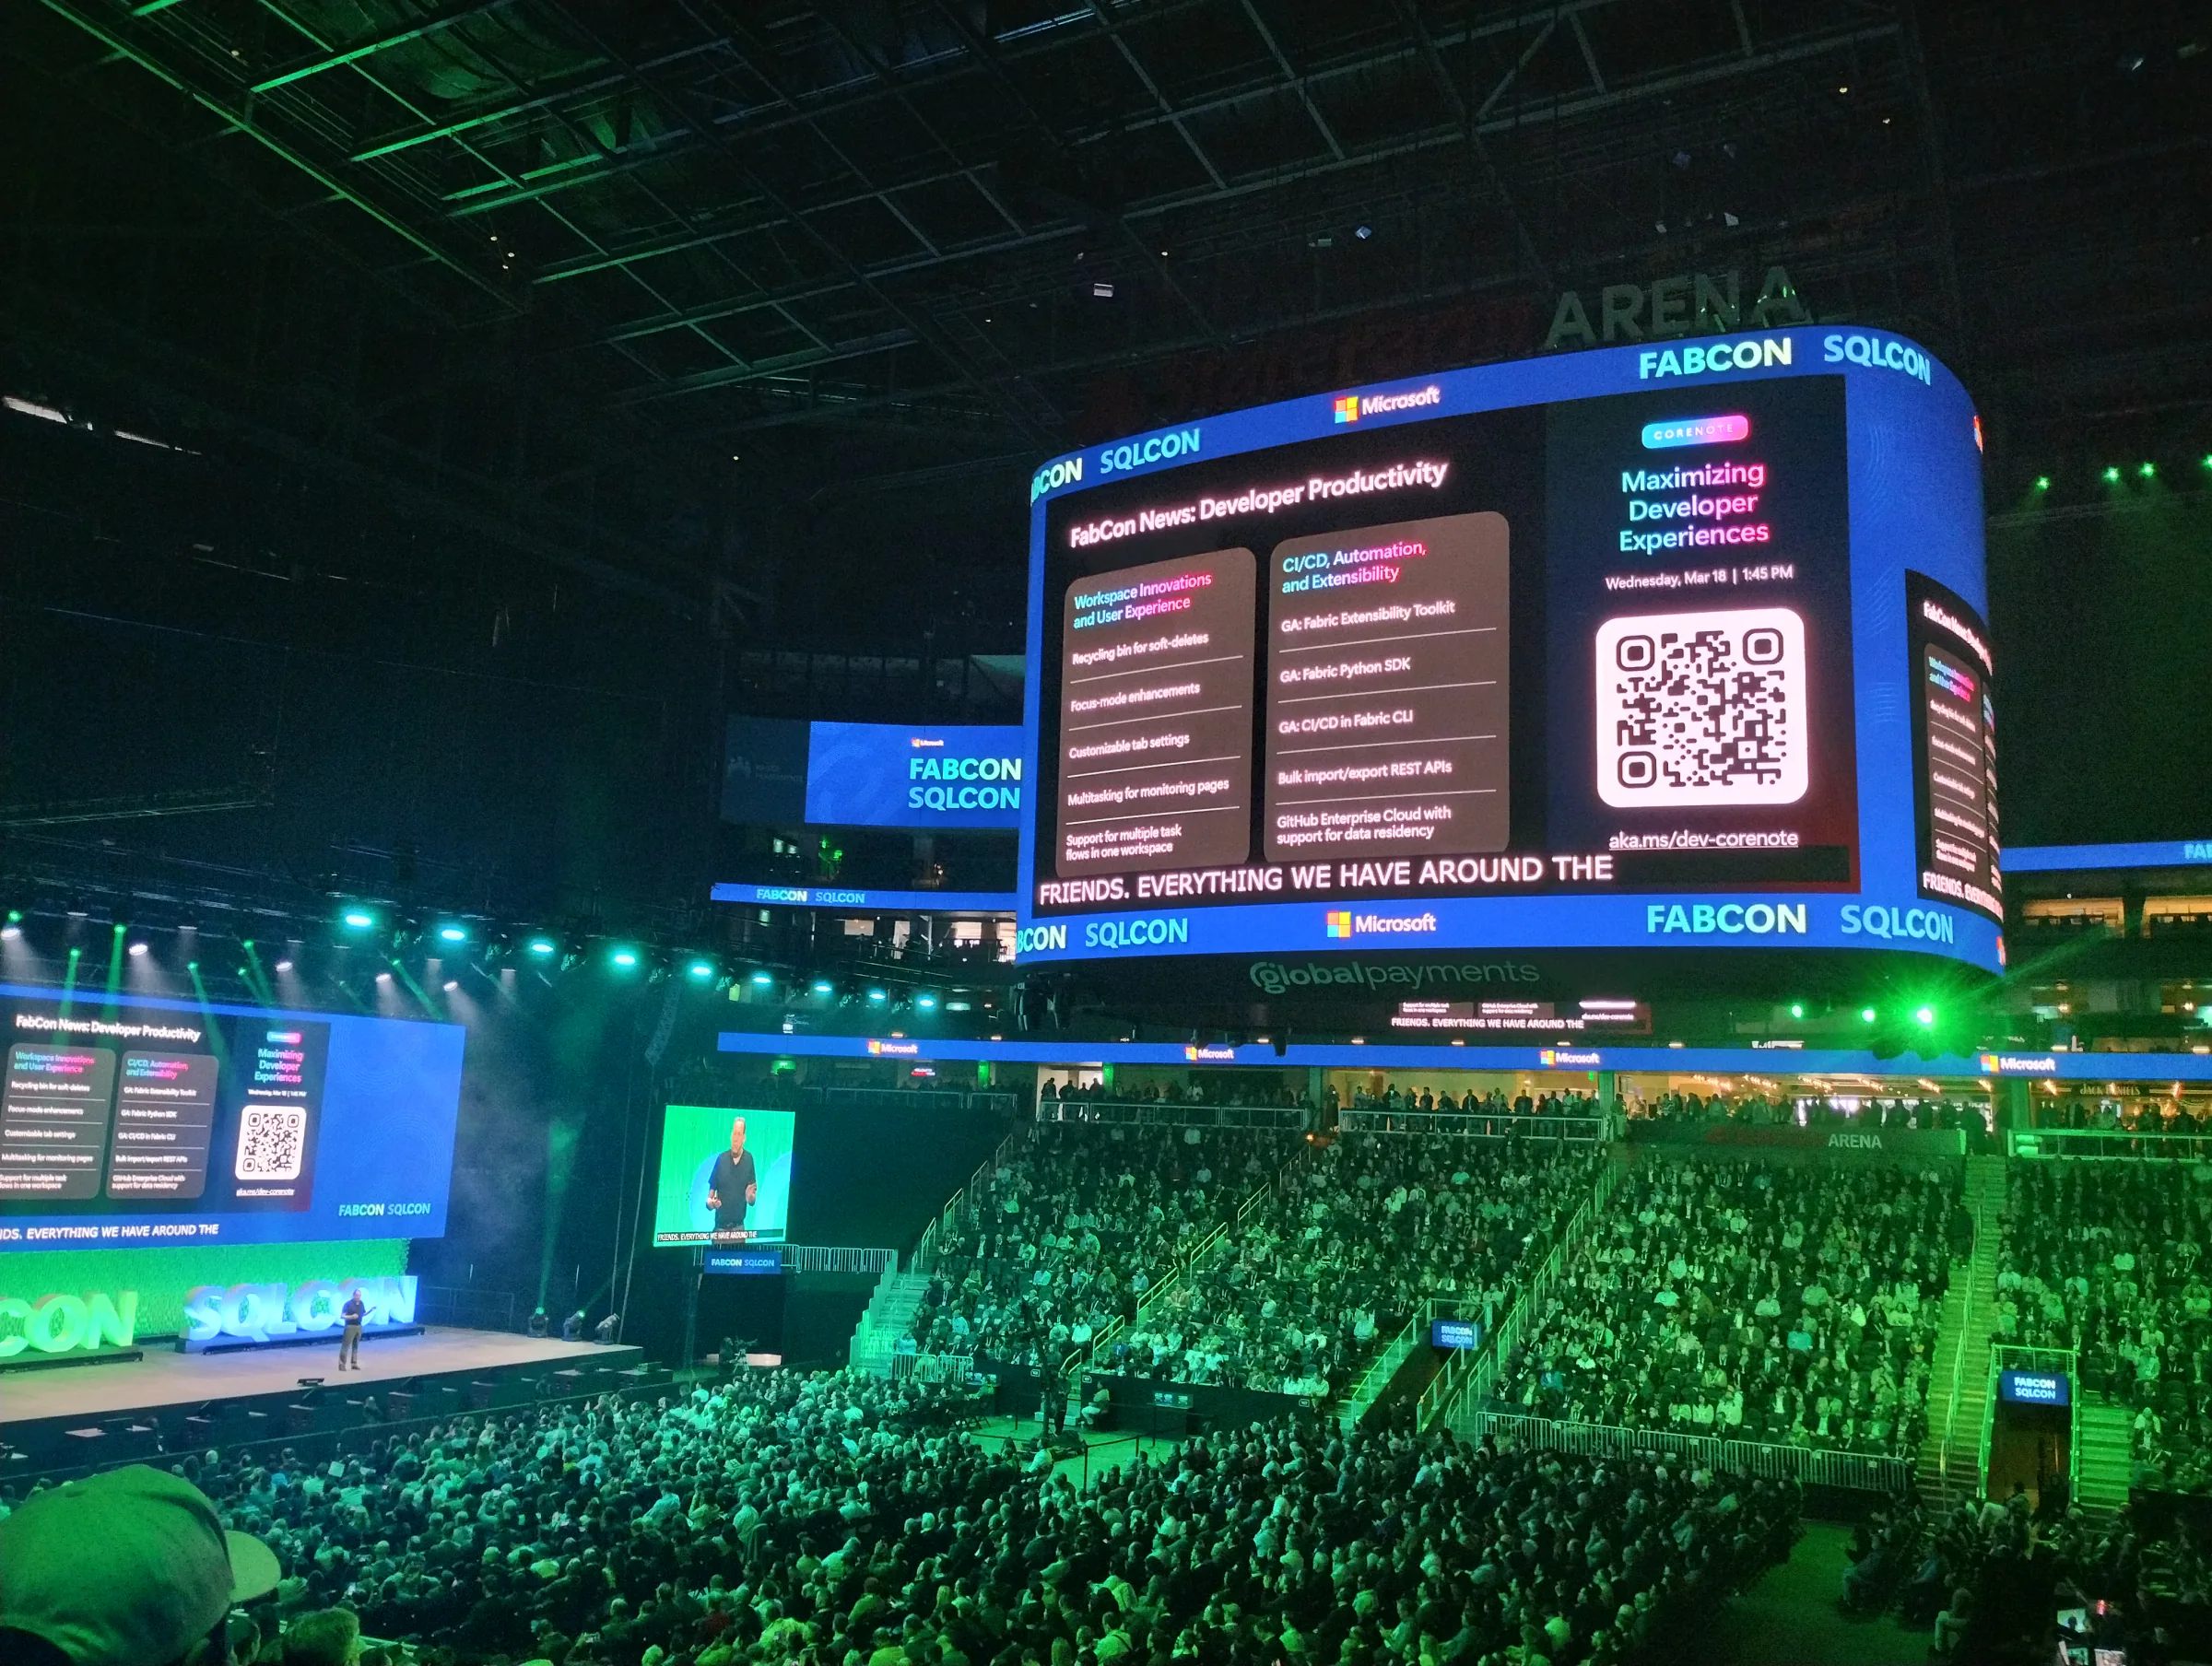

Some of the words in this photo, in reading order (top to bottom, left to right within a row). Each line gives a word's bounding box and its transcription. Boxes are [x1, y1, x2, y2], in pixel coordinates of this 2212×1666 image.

[1545, 265, 1811, 350] ARENA
[1640, 337, 1791, 379] FABCON
[1824, 334, 1931, 386] SQLCON
[1362, 385, 1441, 415] Microsoft
[1653, 424, 1734, 440] CORENOTE
[1100, 428, 1200, 474] SQLCON
[1621, 462, 1764, 493] Maximizing
[1070, 518, 1135, 548] FabCon
[1139, 506, 1196, 533] News:
[1200, 486, 1305, 521] Developer
[1309, 460, 1449, 500] Productivity
[1629, 494, 1759, 521] Developer
[1619, 523, 1769, 556] Experiences
[1282, 553, 1330, 573] CI/CD,
[1333, 542, 1427, 565] Automation,
[1074, 585, 1137, 609] Workspace
[1139, 572, 1212, 597] Innovations
[1282, 576, 1309, 593] and
[1312, 566, 1400, 589] Extensibility
[1606, 573, 1681, 591] Wednesday,
[1684, 570, 1710, 585] Mar
[1712, 569, 1727, 583] 18
[1742, 566, 1769, 581] 1:45
[1771, 564, 1794, 580] PM
[1073, 613, 1094, 629] and
[1097, 608, 1124, 624] User
[1124, 596, 1191, 620] Experience
[1281, 619, 1303, 632] GA:
[1304, 614, 1338, 629] Fabric
[1341, 605, 1412, 626] Extensibility
[1413, 599, 1455, 617] Toolkit
[1072, 644, 1115, 665] Recycling
[1117, 642, 1132, 656] bin
[1133, 640, 1147, 655] for
[1148, 632, 1209, 651] soft-deletes
[1280, 670, 1301, 683] GA:
[1302, 664, 1338, 681] Fabric
[1339, 661, 1382, 678] Python
[1384, 656, 1411, 671] SDK
[1071, 692, 1127, 712] Focus-mode
[1128, 682, 1200, 703] enhancements
[1278, 722, 1300, 734] GA:
[1301, 716, 1338, 732] CI/CD
[1340, 714, 1352, 728] in
[1354, 711, 1391, 727] Fabric
[1393, 710, 1414, 723] CLI
[1069, 740, 1131, 759] Customizable
[1132, 736, 1147, 751] tab
[1149, 733, 1190, 749] settings
[910, 757, 1022, 780] FABCON
[1278, 769, 1302, 785] Bulk
[1304, 765, 1388, 784] import/export
[1391, 761, 1422, 776] REST
[1424, 759, 1453, 774] APIs
[908, 786, 1020, 811] SQLCON
[1067, 789, 1123, 806] Multitasking
[1125, 786, 1138, 799] for
[1140, 781, 1195, 798] monitoring
[1197, 779, 1230, 794] pages
[1277, 813, 1319, 828] GitHub
[1321, 809, 1381, 827] Enterprise
[1382, 806, 1421, 822] Cloud
[1423, 804, 1452, 820] with
[1066, 832, 1102, 849] Support
[1105, 829, 1118, 843] for
[1120, 826, 1159, 842] multiple
[1160, 823, 1182, 838] task
[1277, 829, 1324, 847] support
[1324, 827, 1344, 841] for
[1345, 827, 1371, 840] data
[1373, 825, 1435, 840] residency
[1609, 828, 1798, 850] aka.ms/dev-corenote
[1065, 847, 1089, 861] flows
[1091, 846, 1100, 859] in
[1100, 846, 1120, 858] one
[1121, 841, 1173, 857] workspace
[1040, 877, 1130, 906] FRIENDS.
[1137, 868, 1283, 898] EVERYTHING
[1290, 864, 1331, 890] WE
[1340, 861, 1411, 887] HAVE
[1419, 857, 1543, 885] AROUND
[1552, 854, 1614, 881] THE
[756, 888, 807, 902] FABCON
[815, 891, 865, 904] SQLCON
[1085, 918, 1188, 948] SQLCON
[1355, 912, 1437, 933] Microsoft
[1647, 903, 1806, 933] FABCON
[1841, 905, 1954, 944] SQLCON
[16, 1014, 57, 1030] FabCon
[90, 1020, 142, 1038] Developer
[143, 1024, 201, 1043] Productivity
[1432, 1018, 1485, 1027] EVERYTHING
[1487, 1019, 1500, 1027] WE
[1502, 1019, 1526, 1028] HAVE
[1527, 1019, 1565, 1028] AROUND
[1565, 1019, 1584, 1028] THE
[258, 1048, 304, 1062] Maximizing
[881, 1043, 918, 1054] Microsoft
[1198, 1049, 1234, 1059] Microsoft
[1555, 1052, 1600, 1063] Microsoft
[254, 1071, 302, 1083] Experiences
[259, 1060, 300, 1073] Developer
[2000, 1057, 2056, 1072] Microsoft
[1828, 1133, 1883, 1149] ARENA
[338, 1203, 384, 1216] FABCON
[387, 1203, 431, 1216] SQLCON
[27, 1226, 99, 1239] EVERYTHING
[101, 1226, 119, 1238] WE
[121, 1225, 149, 1238] HAVE
[152, 1224, 196, 1237] AROUND
[198, 1224, 219, 1235] THE
[711, 1258, 742, 1267] FABCON
[744, 1259, 774, 1268] SQLCON
[183, 1275, 418, 1342] SQLCON
[2014, 1377, 2056, 1390] FABCON
[2015, 1387, 2056, 1400] SQLCON
